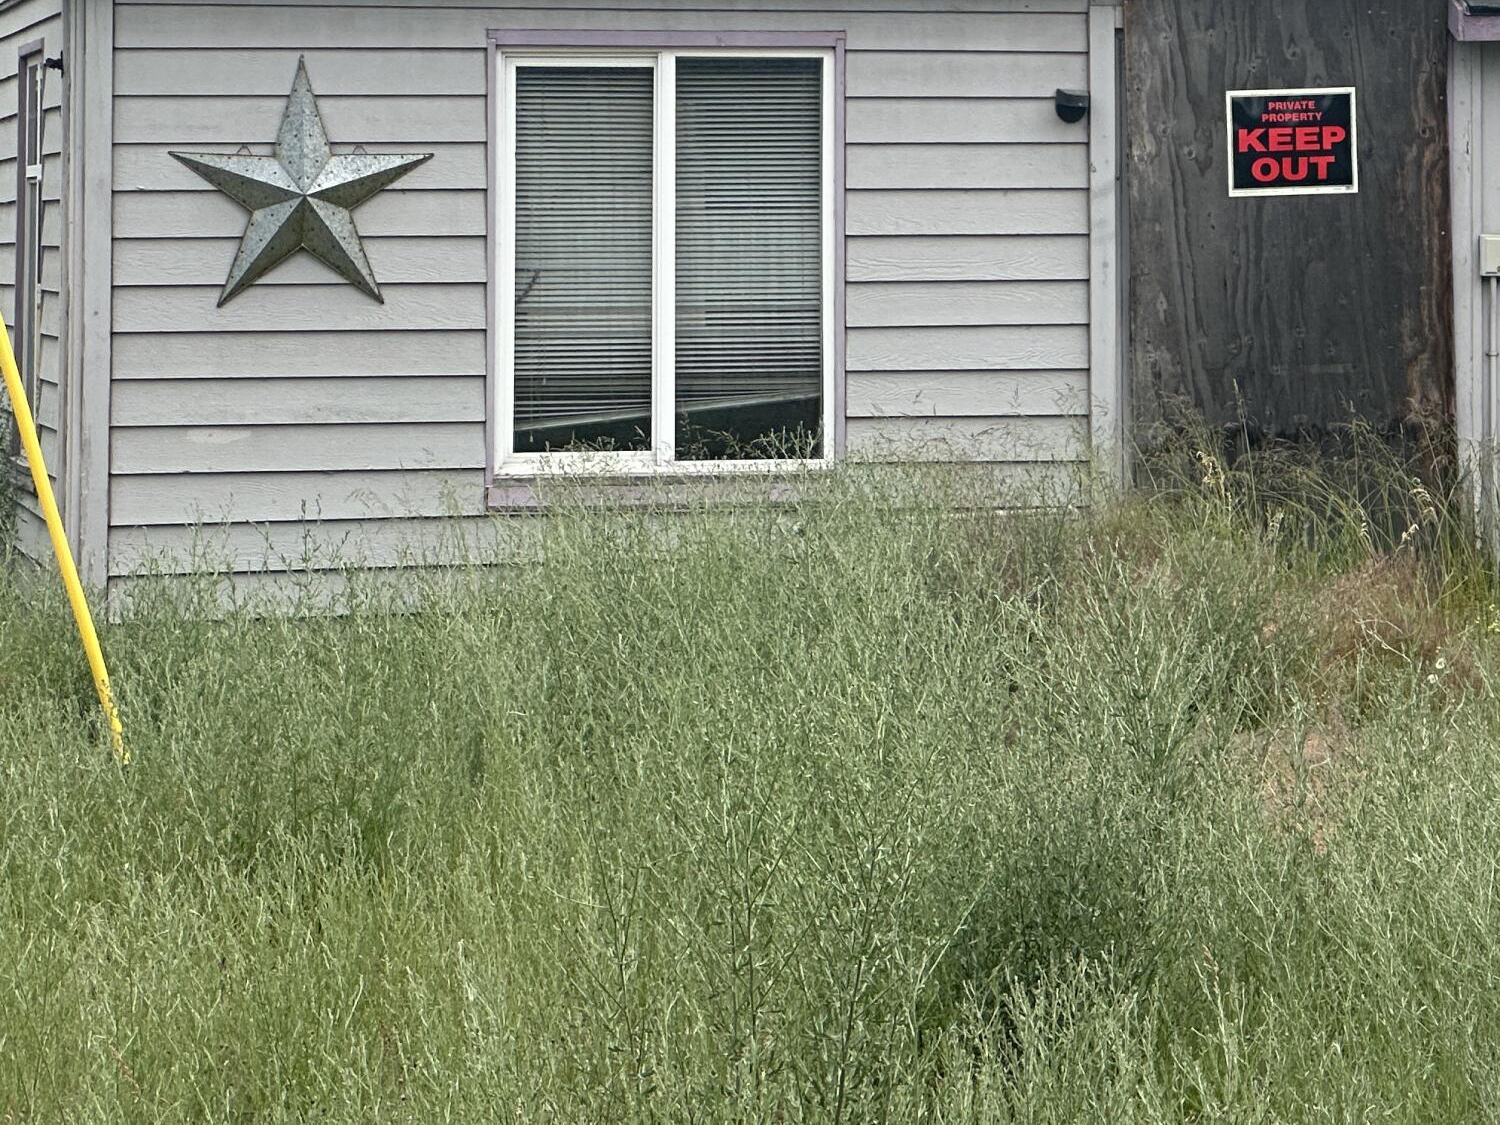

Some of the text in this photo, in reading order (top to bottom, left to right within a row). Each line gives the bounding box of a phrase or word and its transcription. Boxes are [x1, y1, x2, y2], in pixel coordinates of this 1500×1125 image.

[1268, 100, 1316, 110] PRIVATE
[1262, 112, 1323, 122] PROPERTY
[1238, 126, 1346, 152] KEEP
[1251, 155, 1336, 182] OUT
